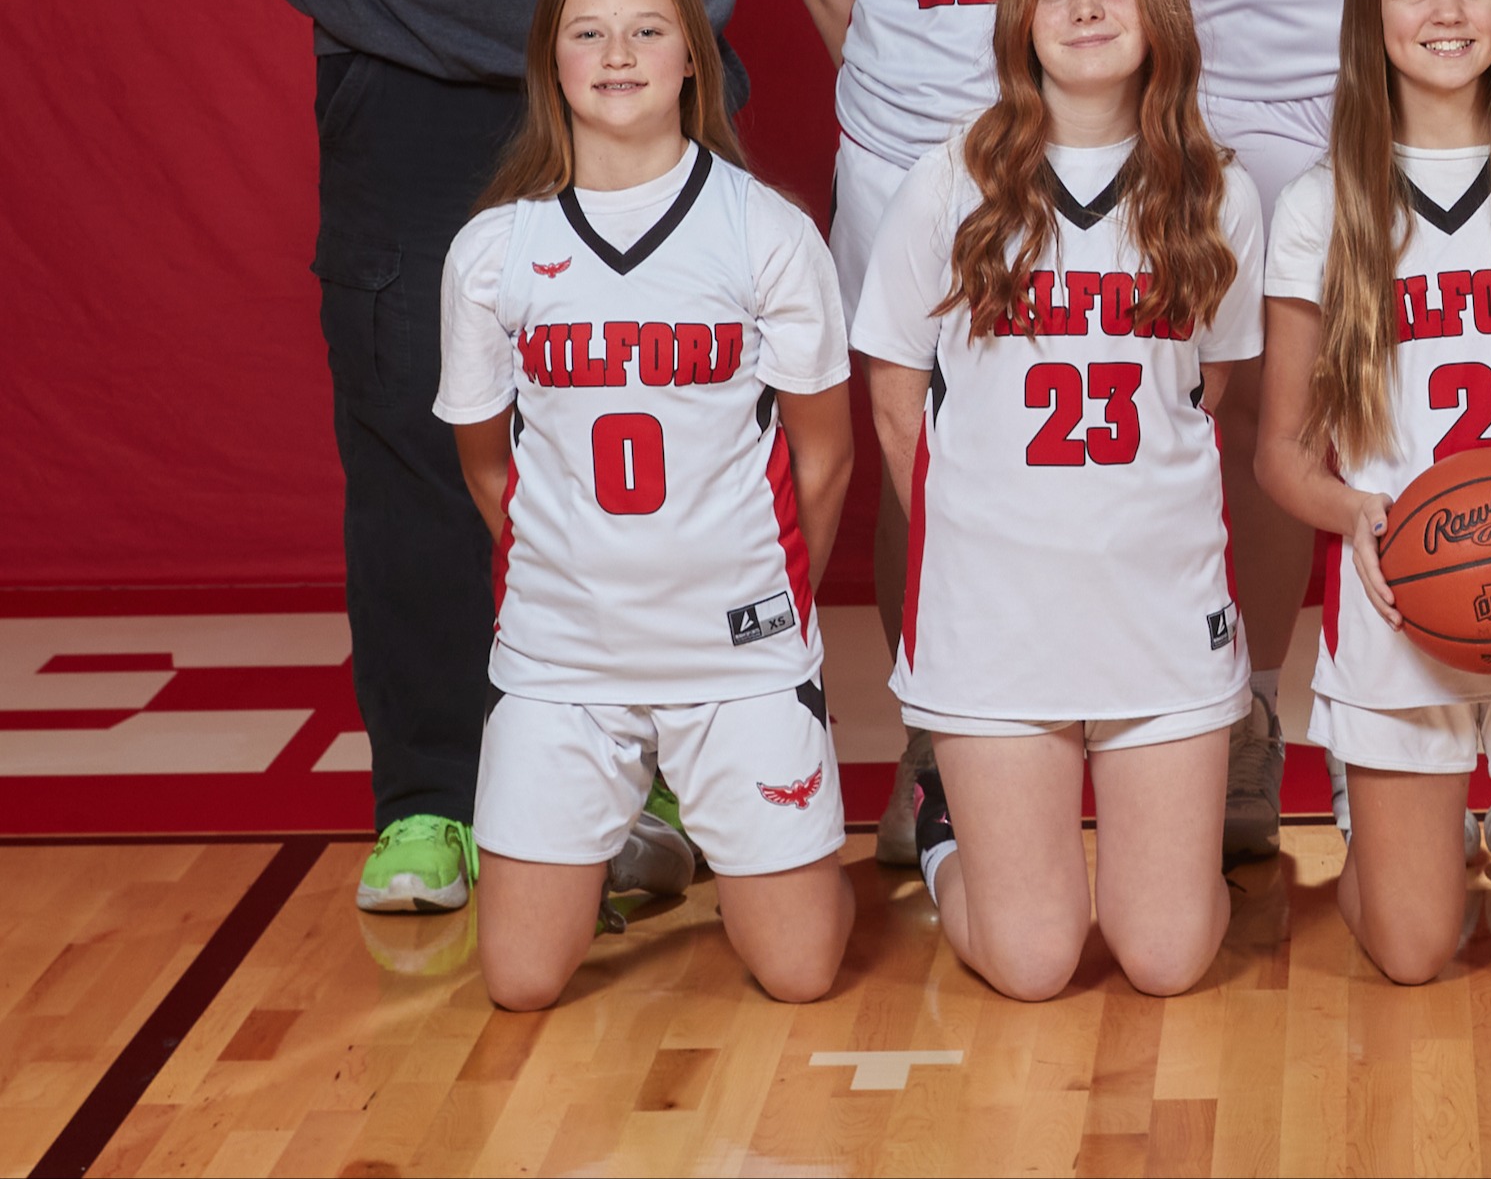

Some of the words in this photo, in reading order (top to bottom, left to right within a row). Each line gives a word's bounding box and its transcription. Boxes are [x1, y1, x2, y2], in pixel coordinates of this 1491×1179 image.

[517, 321, 743, 388] MILFORD
[1024, 362, 1143, 466] 23
[591, 412, 667, 515] 0
[768, 615, 787, 631] XS
